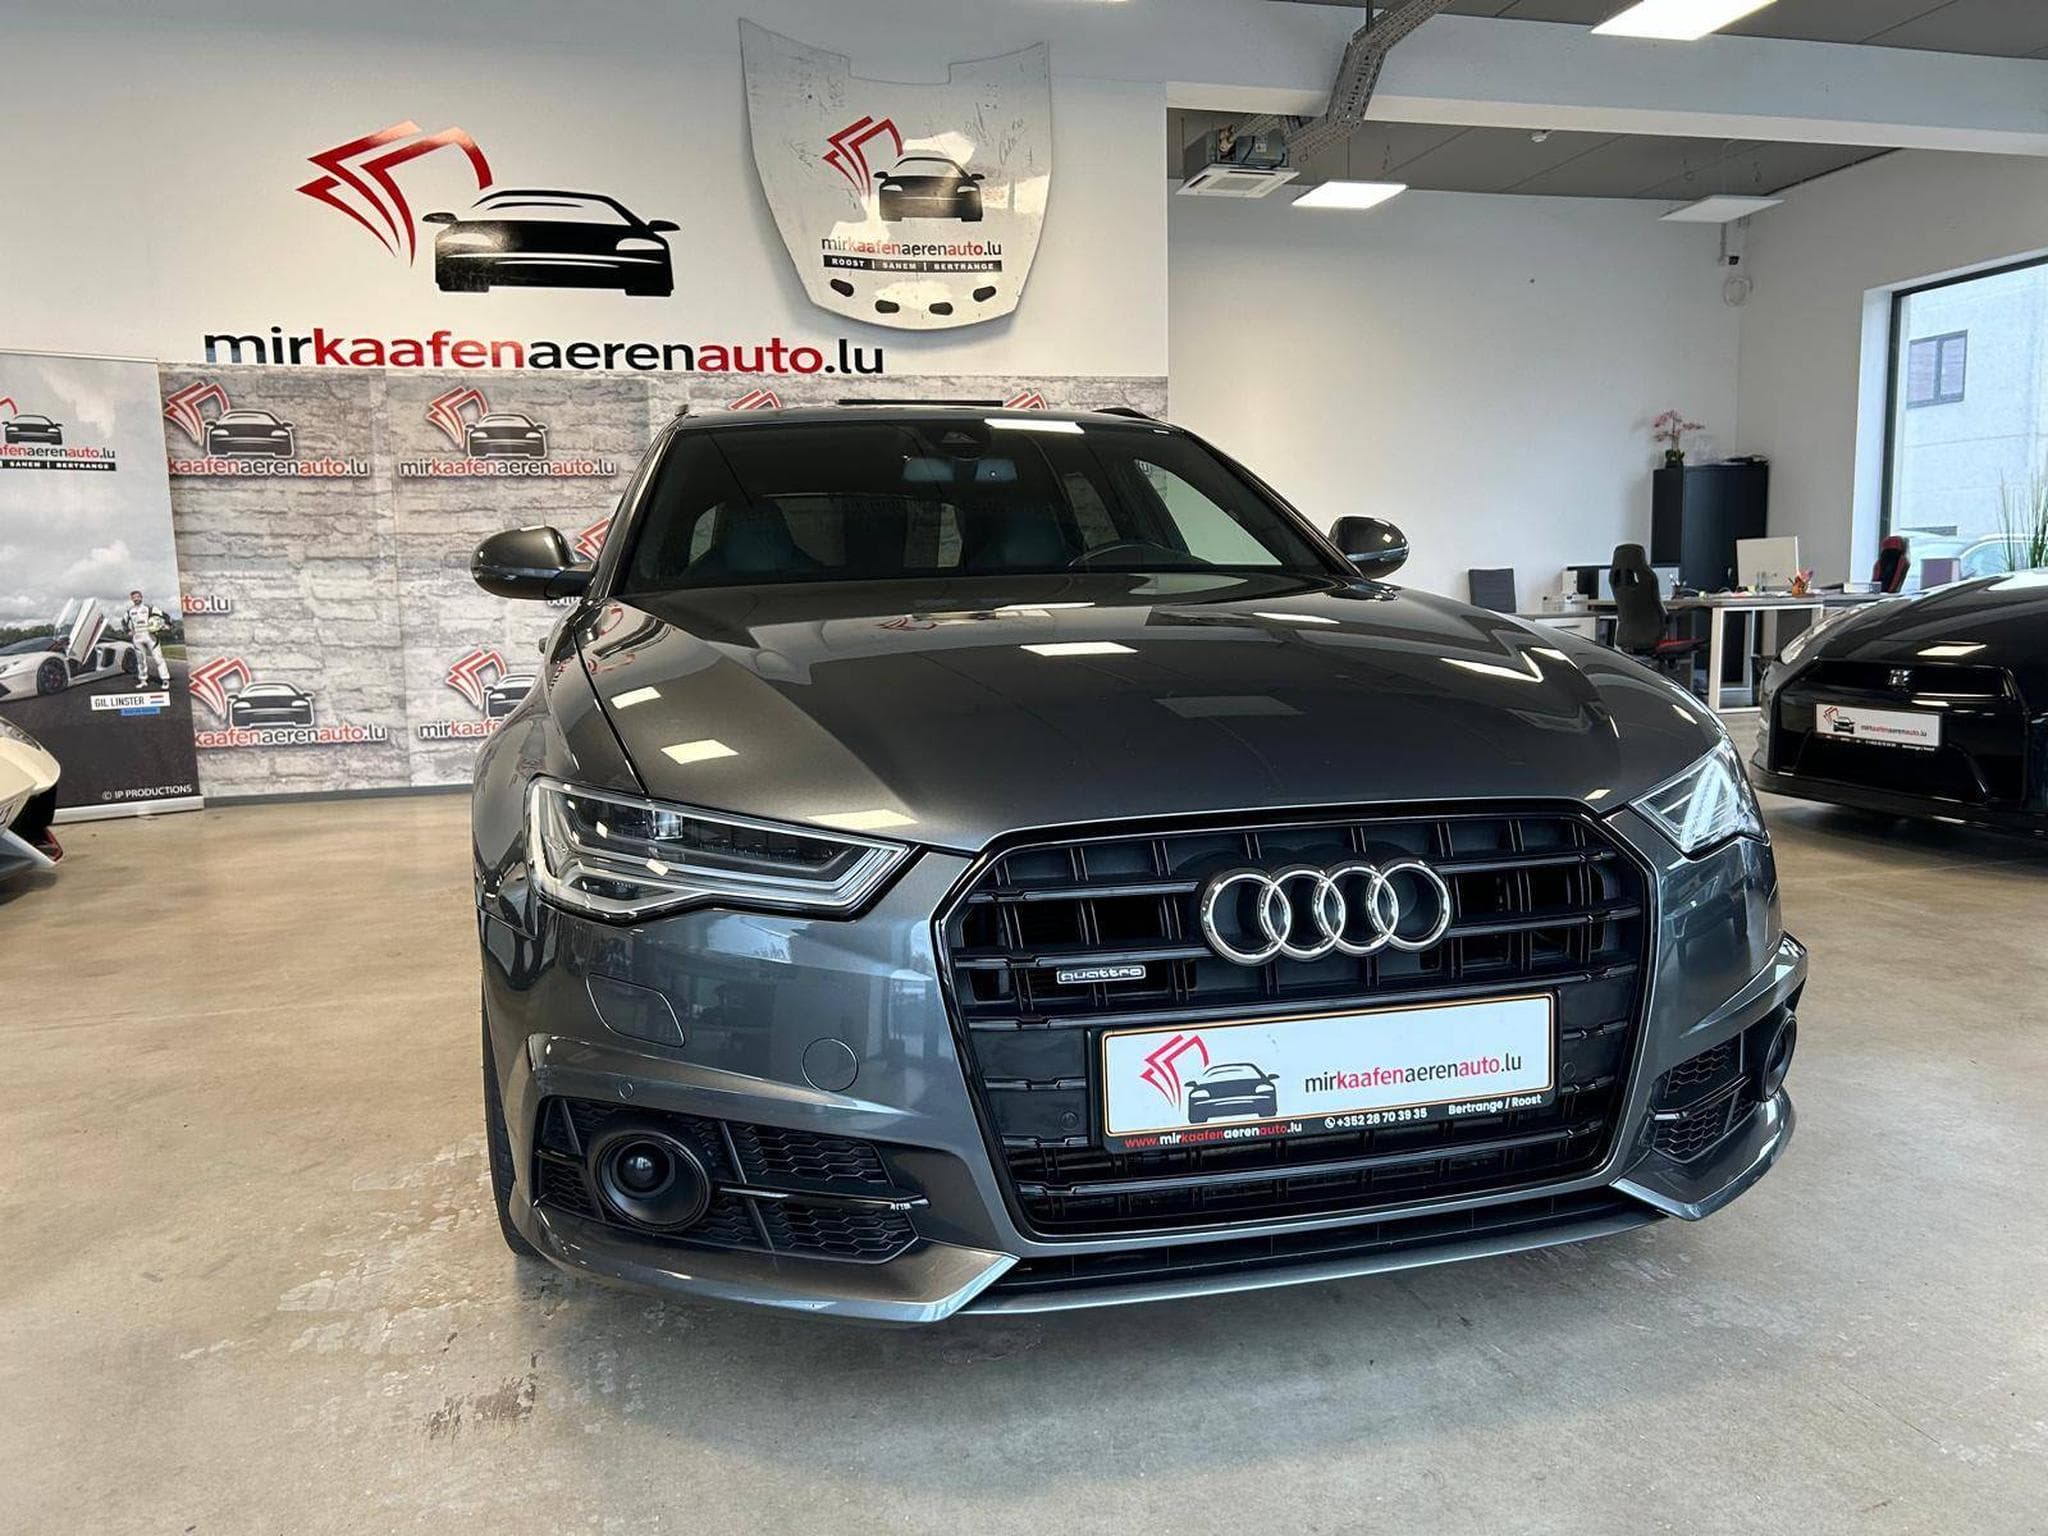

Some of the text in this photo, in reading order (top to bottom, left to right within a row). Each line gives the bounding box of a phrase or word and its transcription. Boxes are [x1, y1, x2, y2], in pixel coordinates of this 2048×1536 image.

[821, 236, 1002, 256] mirkaafenaerenauto.lu
[832, 258, 865, 268] ROOST
[934, 263, 994, 271] BERTRANGE
[205, 327, 883, 374] mirkaafenaerenauto.lu
[0, 445, 115, 459] fenaerenauto.lu
[400, 458, 615, 476] mirkaafenaerenauto.lu
[95, 696, 144, 708] GIL LINSTER
[114, 790, 124, 799] IP
[126, 784, 192, 798] PRODUCTIONS
[1061, 968, 1142, 981] quattro
[1304, 1053, 1522, 1093] mirkaafenaerenauto.lu
[1124, 1122, 1302, 1148] www.mirkaafenaerenauto.lu
[1337, 1113, 1365, 1127] +352
[1366, 1111, 1380, 1124] 28
[1382, 1110, 1395, 1122] 70
[1414, 1107, 1427, 1119] 35
[1448, 1099, 1503, 1116] Bertrange
[1511, 1094, 1542, 1107] Roost
